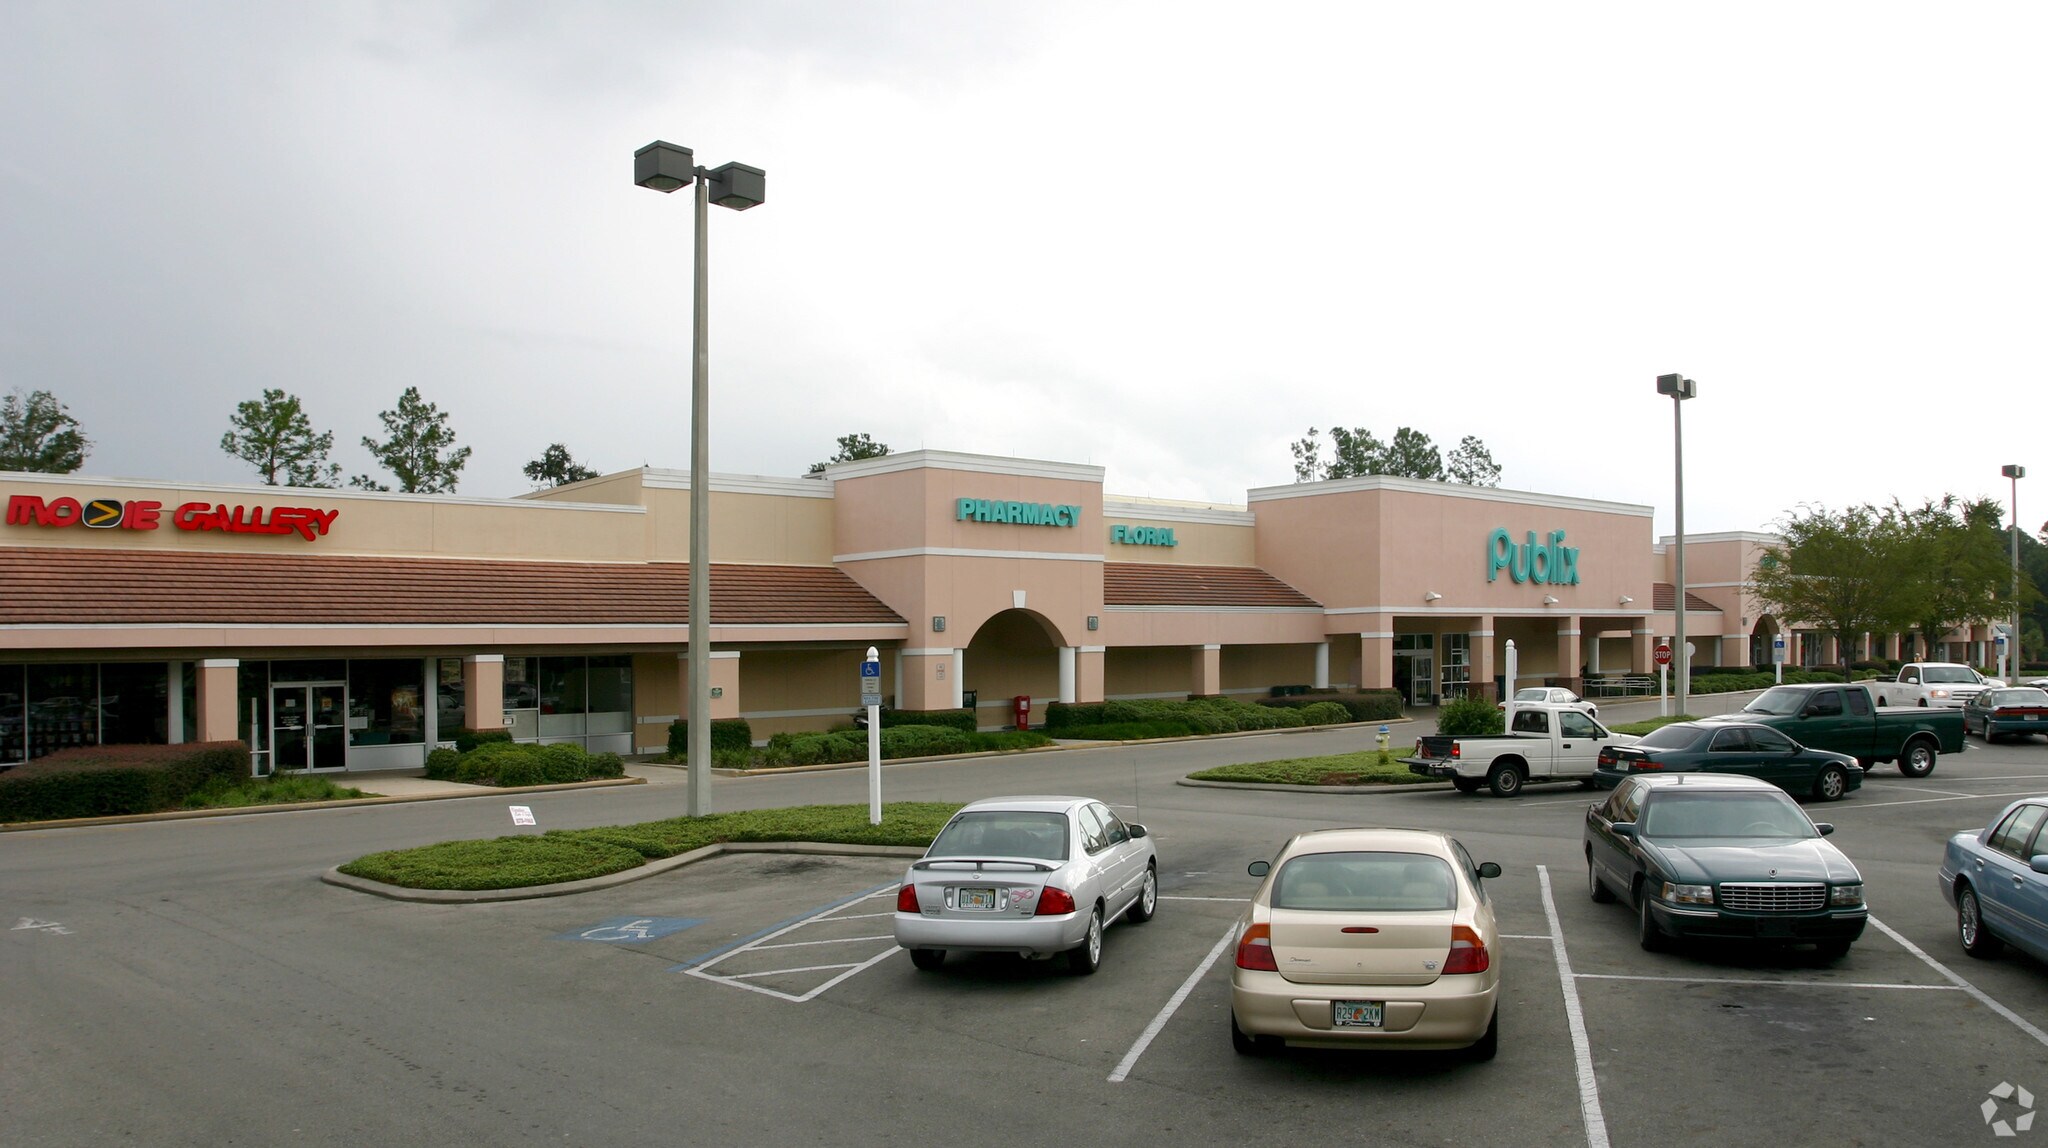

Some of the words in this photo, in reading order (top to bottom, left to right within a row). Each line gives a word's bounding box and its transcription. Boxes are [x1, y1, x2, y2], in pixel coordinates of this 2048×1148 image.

[6, 495, 162, 530] MOVIE
[174, 502, 339, 541] GALLERY
[956, 497, 1082, 528] PHARMACY
[1110, 524, 1178, 547] FLORAL
[1487, 527, 1581, 585] Publix
[1655, 651, 1671, 659] STOP
